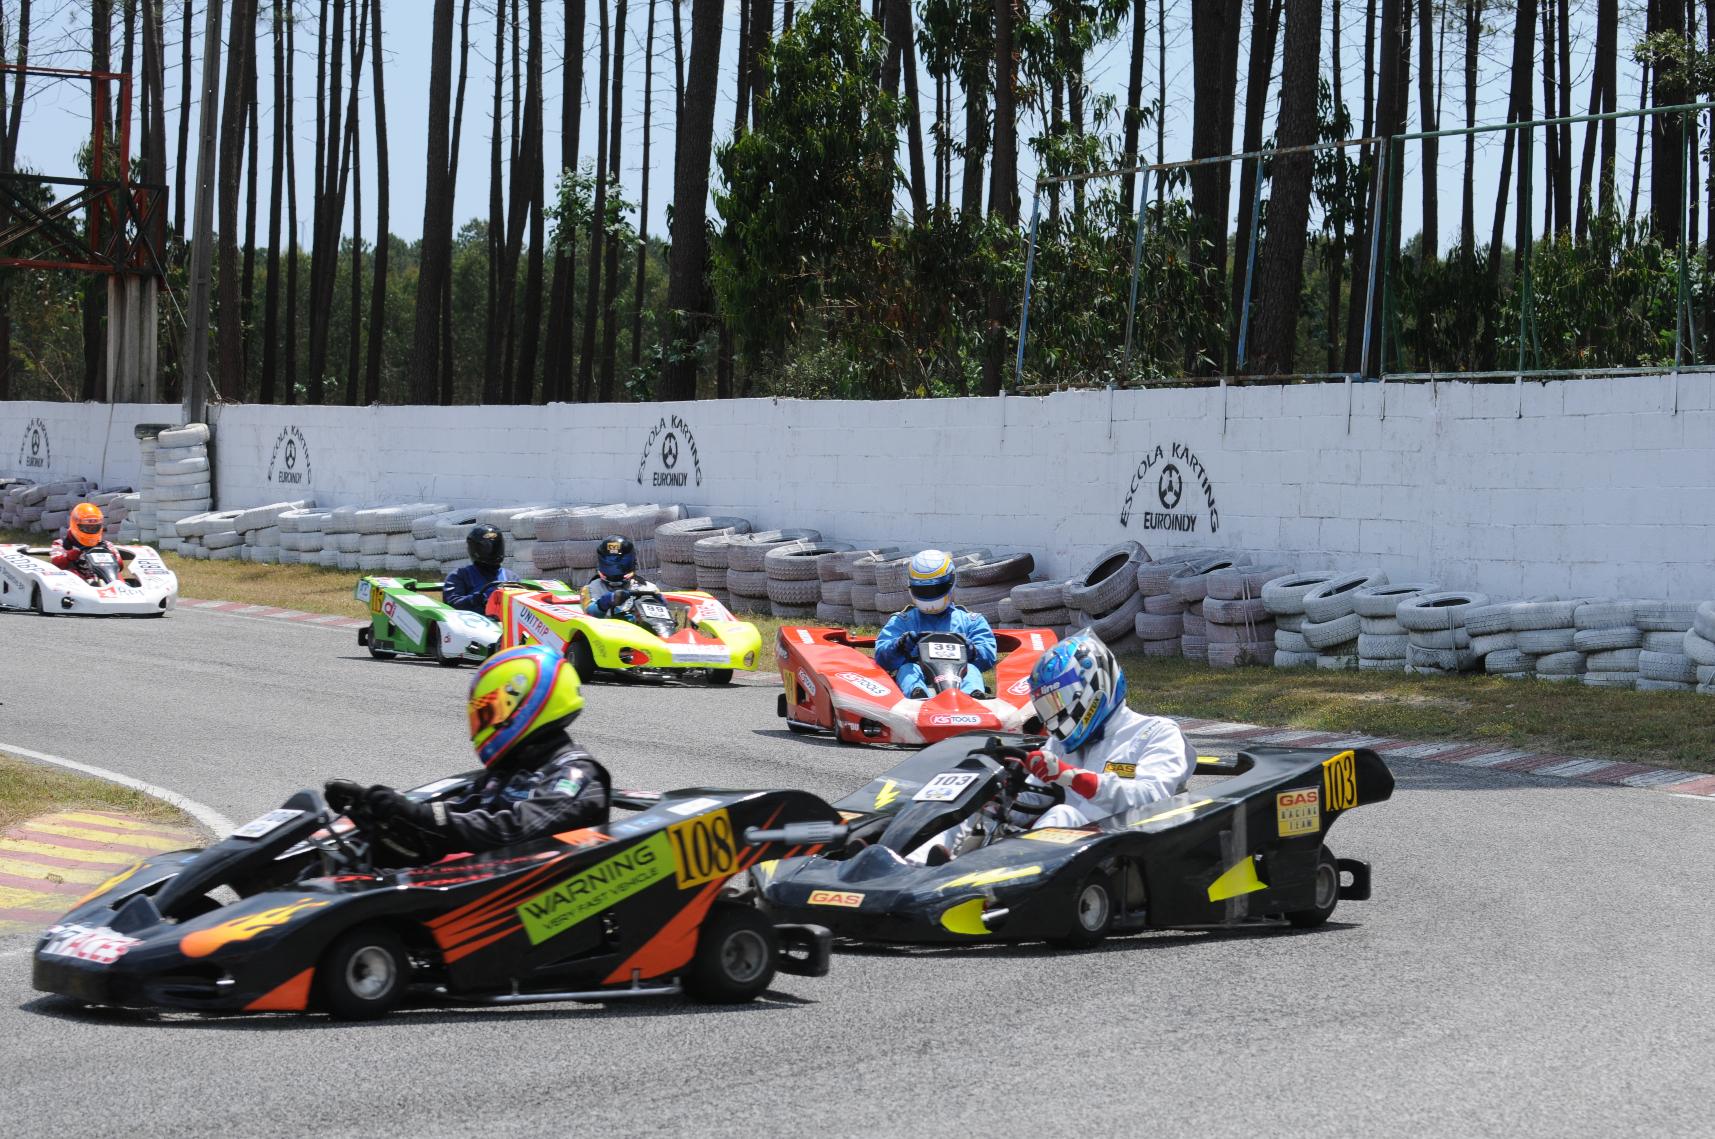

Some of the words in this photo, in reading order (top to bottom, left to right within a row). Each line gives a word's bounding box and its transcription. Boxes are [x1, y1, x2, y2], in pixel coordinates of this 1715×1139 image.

[637, 416, 667, 486] ESCOLA
[671, 413, 703, 488] KARTING
[652, 471, 688, 487] EUROINDY
[1120, 444, 1164, 528] ESCOLA
[1171, 441, 1220, 534] KARTING
[1143, 511, 1197, 532] EUROINDY
[520, 606, 551, 637] UNITRIP
[933, 643, 957, 651] 39
[932, 774, 971, 786] 103
[1104, 762, 1136, 774] GAS
[1325, 755, 1356, 812] 103
[1279, 791, 1318, 807] GAS
[673, 815, 734, 884] 108
[524, 844, 658, 920] WARNING
[543, 911, 575, 929] VERY
[577, 891, 608, 911] FAST
[608, 867, 660, 895] VEHICLE
[811, 891, 862, 906] GAS
